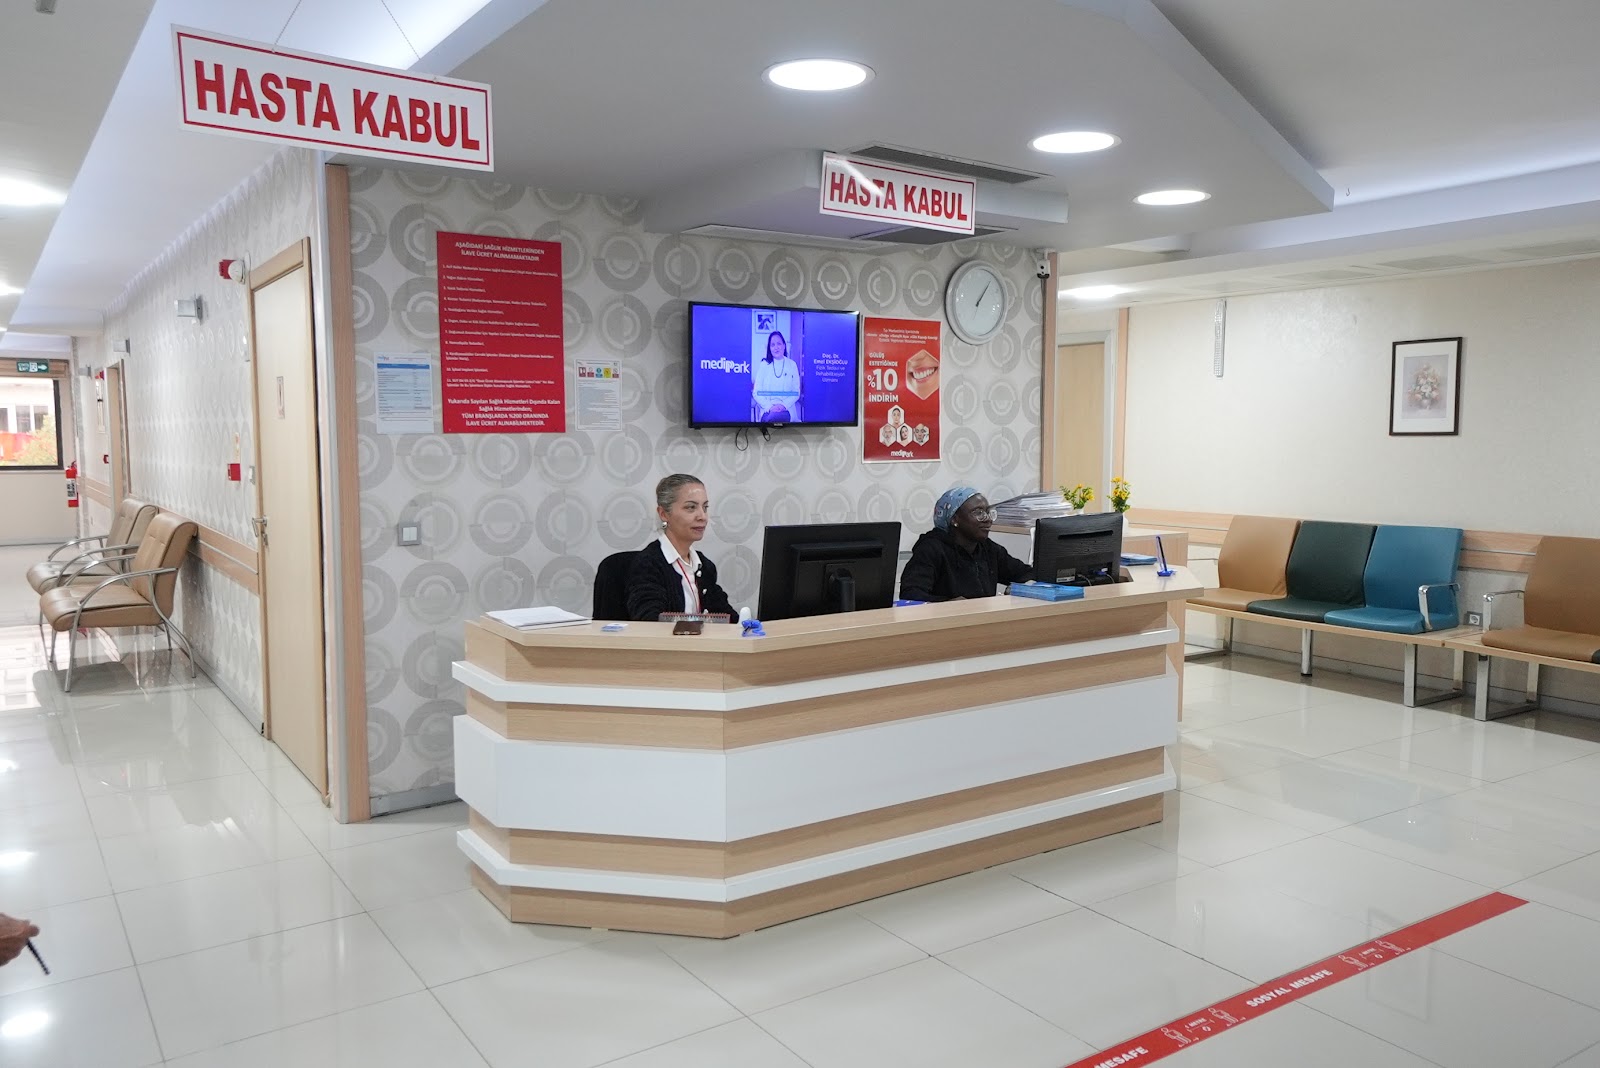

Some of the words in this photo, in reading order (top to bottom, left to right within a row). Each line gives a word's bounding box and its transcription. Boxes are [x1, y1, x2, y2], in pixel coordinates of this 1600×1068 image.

[194, 59, 340, 131] HASTA
[353, 88, 480, 151] KABUL
[830, 171, 897, 211] HASTA
[904, 184, 968, 221] KABUL
[867, 368, 899, 392] %10
[869, 393, 900, 403] İNDİRİM
[1246, 987, 1292, 1007] SOSYAL
[1289, 969, 1334, 989] MESAFE
